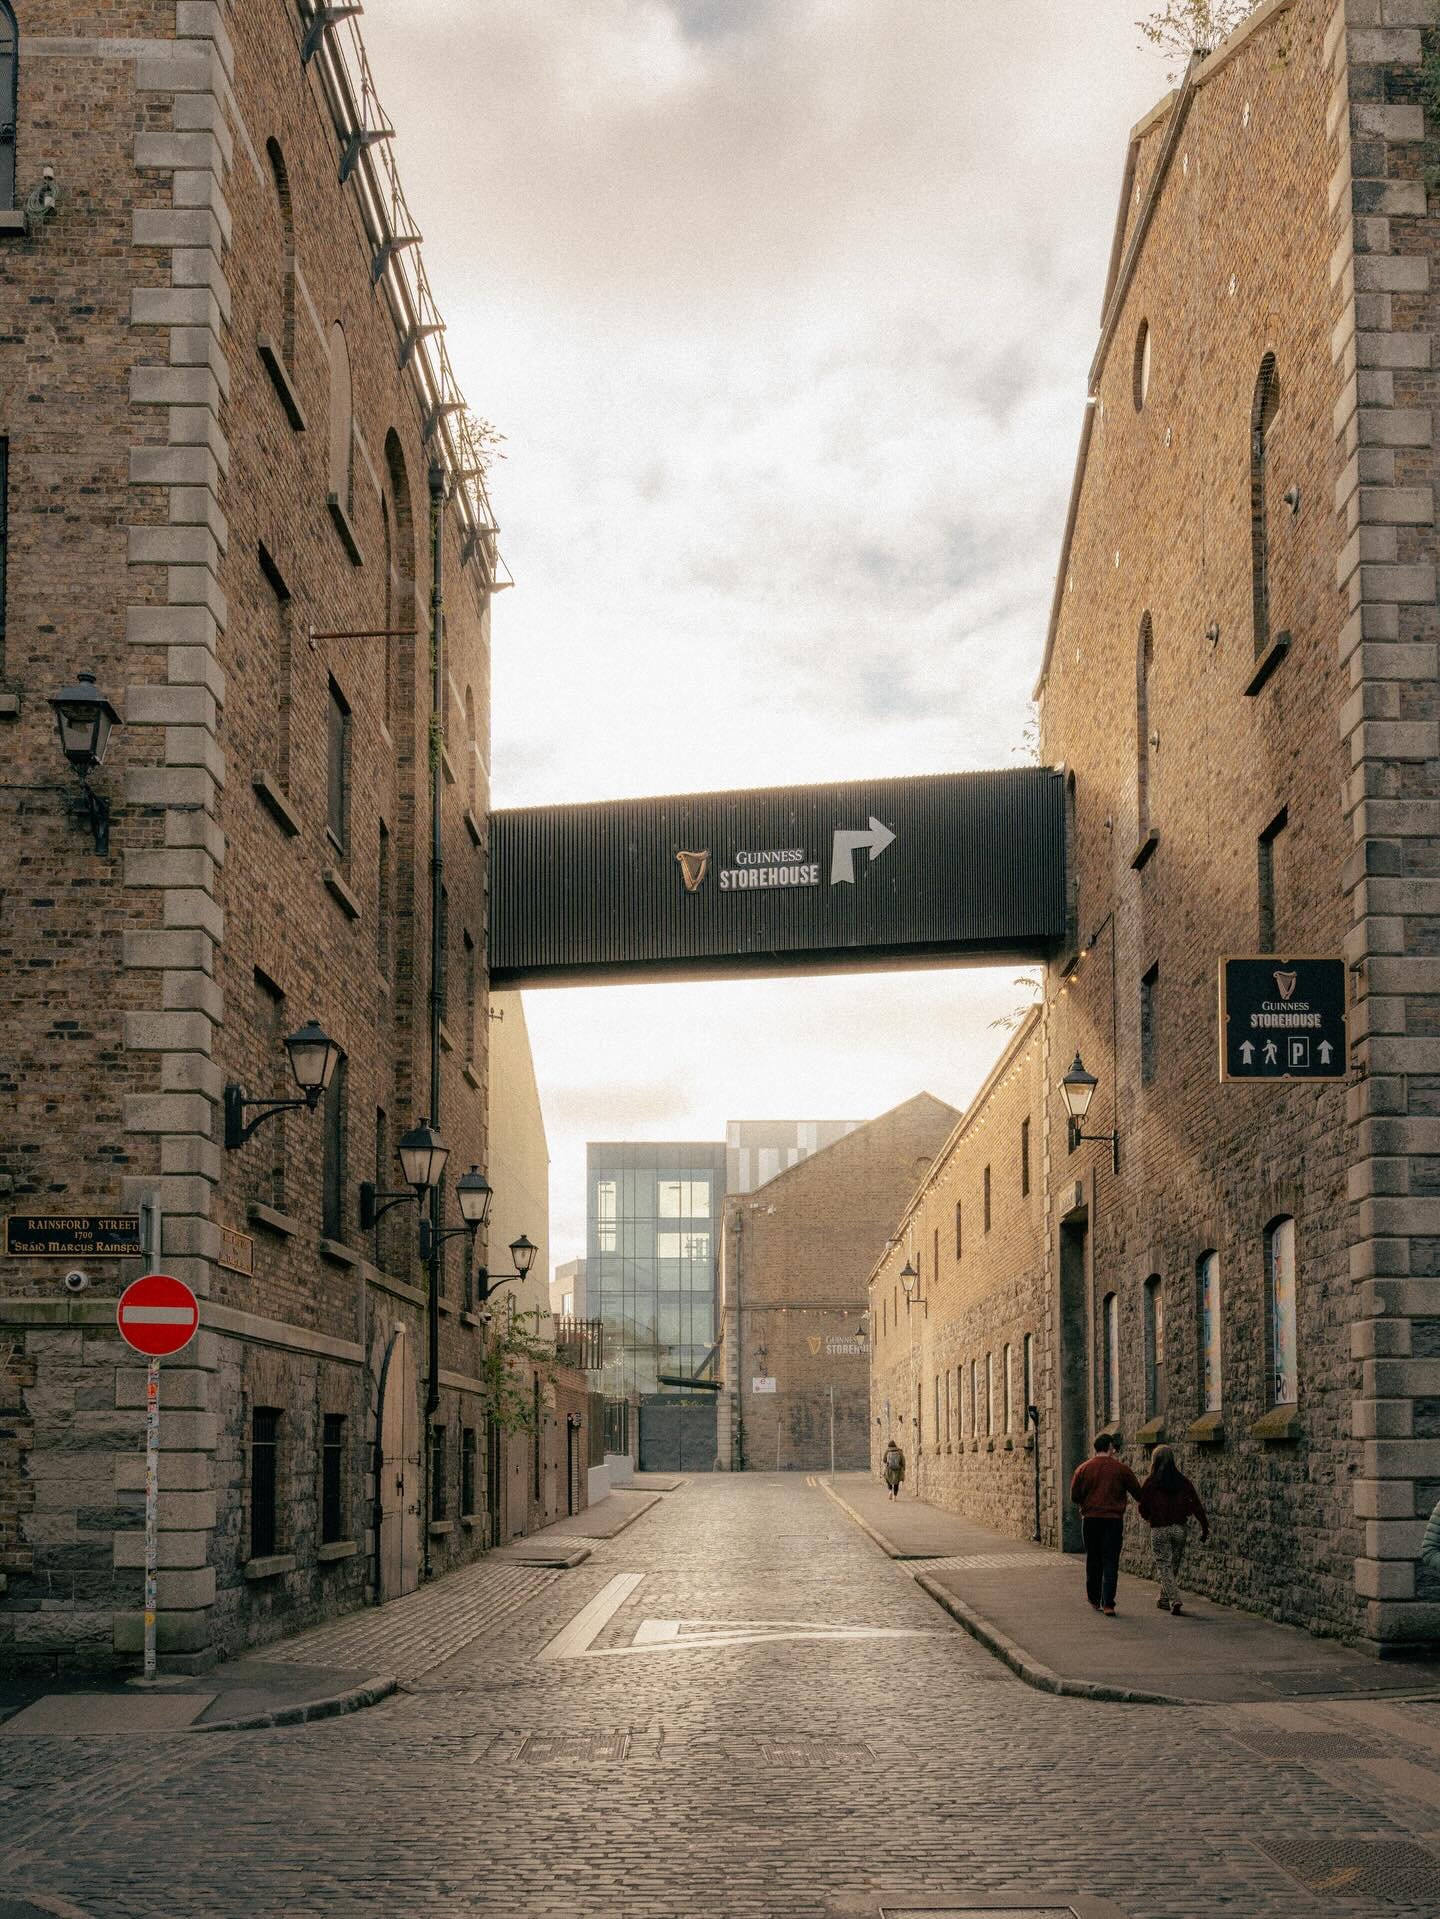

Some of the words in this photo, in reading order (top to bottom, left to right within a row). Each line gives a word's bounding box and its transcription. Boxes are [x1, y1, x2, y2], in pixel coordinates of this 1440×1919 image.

[736, 850, 802, 865] GUINNESS
[720, 864, 818, 889] STOREHOUSE
[1262, 1001, 1310, 1011] GUINNESS
[1250, 1013, 1322, 1028] STOREHOUSE
[1292, 1043, 1304, 1065] P
[28, 1219, 90, 1231] RAINSFORD
[98, 1220, 138, 1231] STREET
[74, 1231, 93, 1240] 1700
